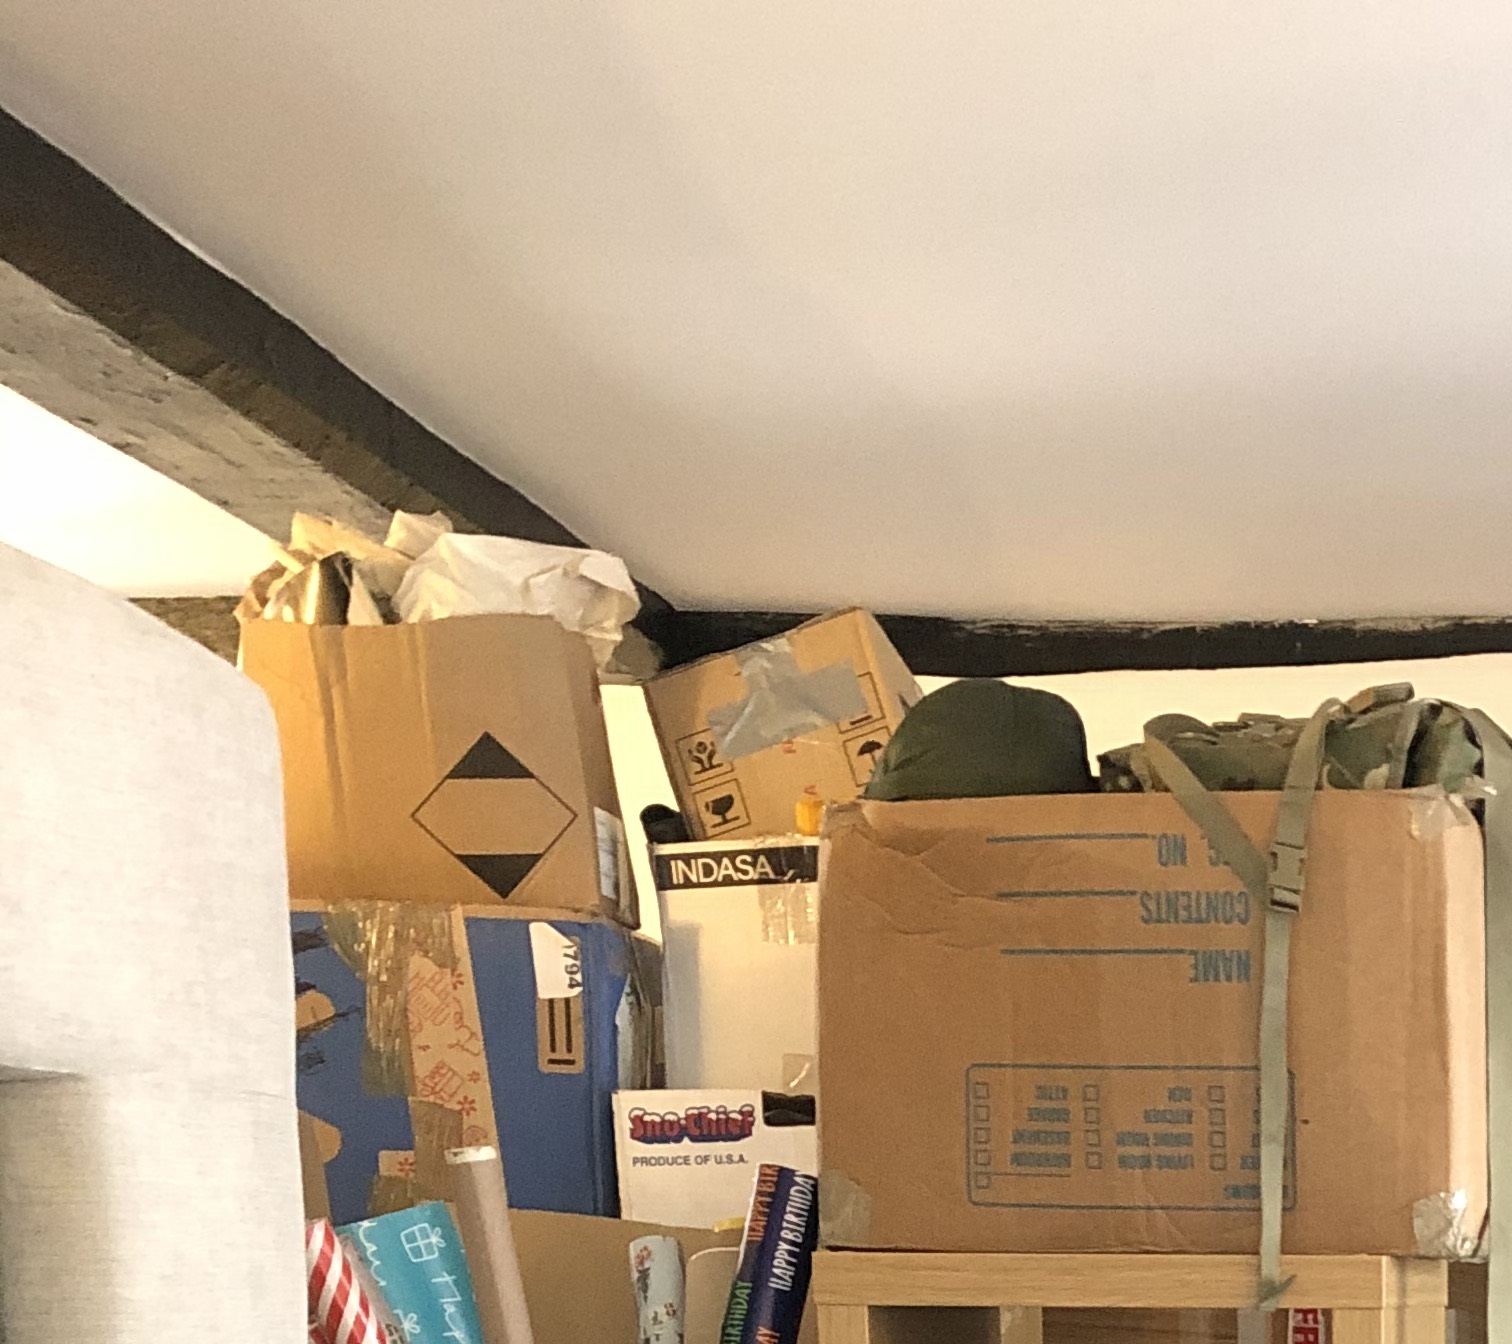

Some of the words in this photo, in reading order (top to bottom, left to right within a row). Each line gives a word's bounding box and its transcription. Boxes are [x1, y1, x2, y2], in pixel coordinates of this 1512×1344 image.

[670, 855, 775, 884] INDASA
[1140, 891, 1249, 925] CONTENTS
[1189, 950, 1250, 983] NAME
[632, 1155, 691, 1167] PRODUCE
[695, 1154, 711, 1166] OF
[714, 1154, 748, 1165] U.S.A.
[768, 1241, 799, 1291] HAPPY
